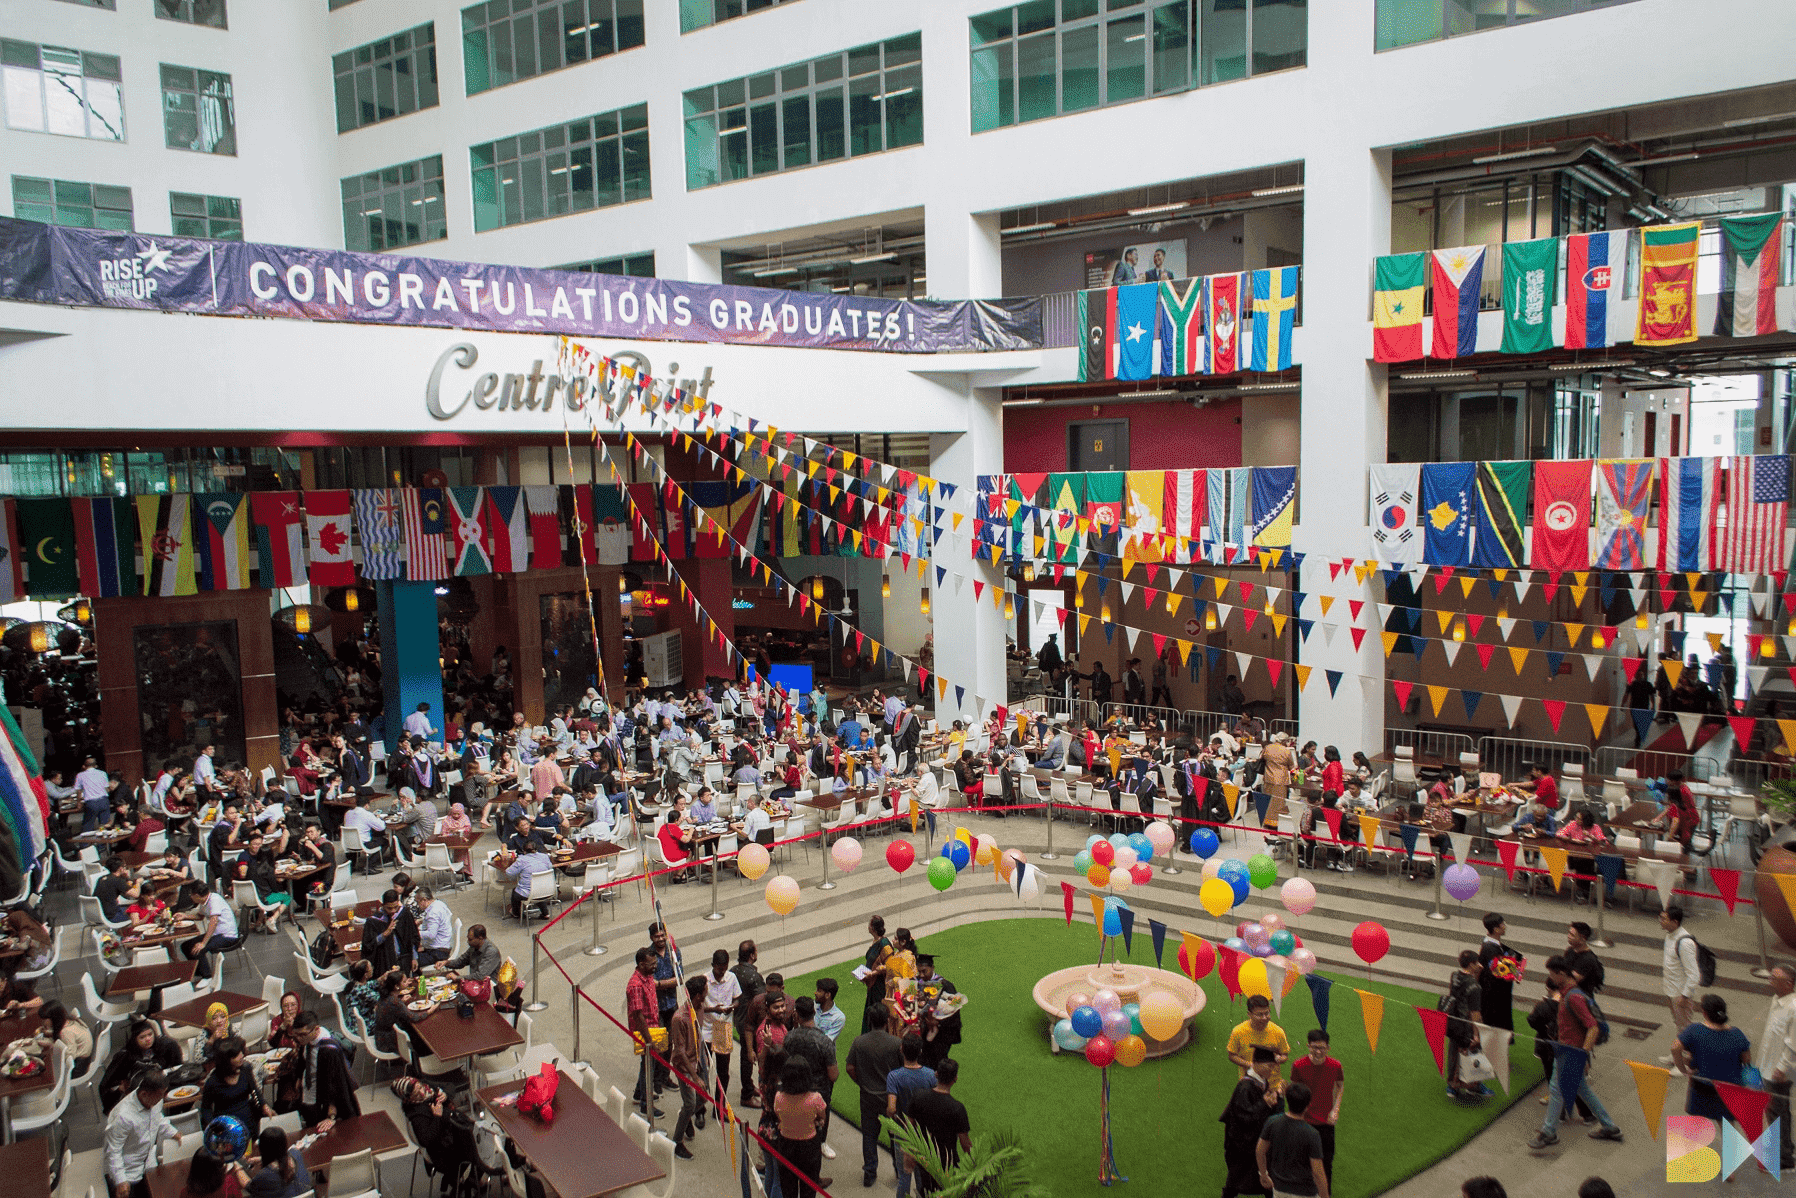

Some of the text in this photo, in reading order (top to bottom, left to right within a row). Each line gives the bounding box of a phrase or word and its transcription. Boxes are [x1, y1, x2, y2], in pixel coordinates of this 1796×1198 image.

[99, 258, 144, 281] RISE
[131, 277, 158, 300] UP
[249, 261, 915, 341] CONGRATULATIONS GRADUATES!
[426, 342, 715, 423] Centre Point
